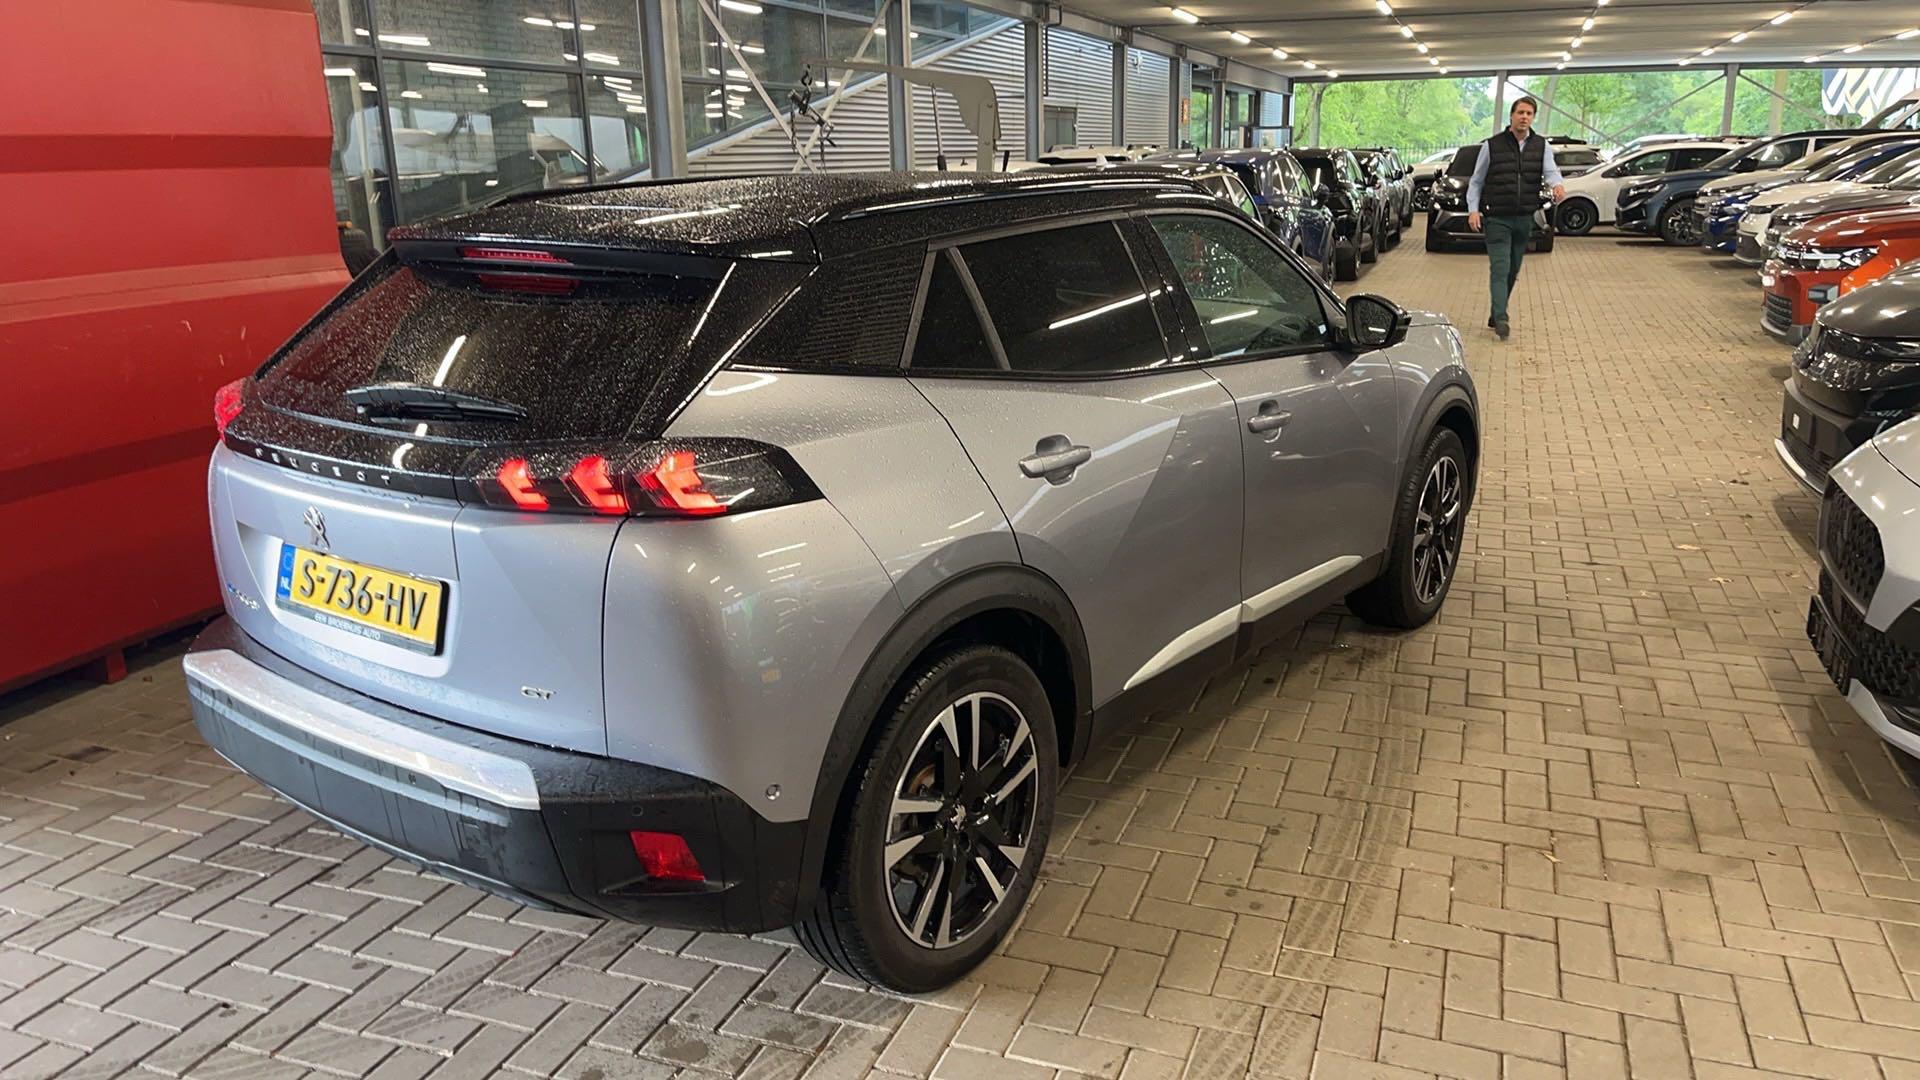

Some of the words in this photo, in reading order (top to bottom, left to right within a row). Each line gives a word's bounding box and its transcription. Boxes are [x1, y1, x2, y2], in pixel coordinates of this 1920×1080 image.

[255, 447, 391, 486] PEUGEOT
[280, 575, 291, 591] NL
[299, 559, 428, 631] S-736-HV
[363, 627, 381, 641] AUTO
[521, 685, 556, 701] GT
